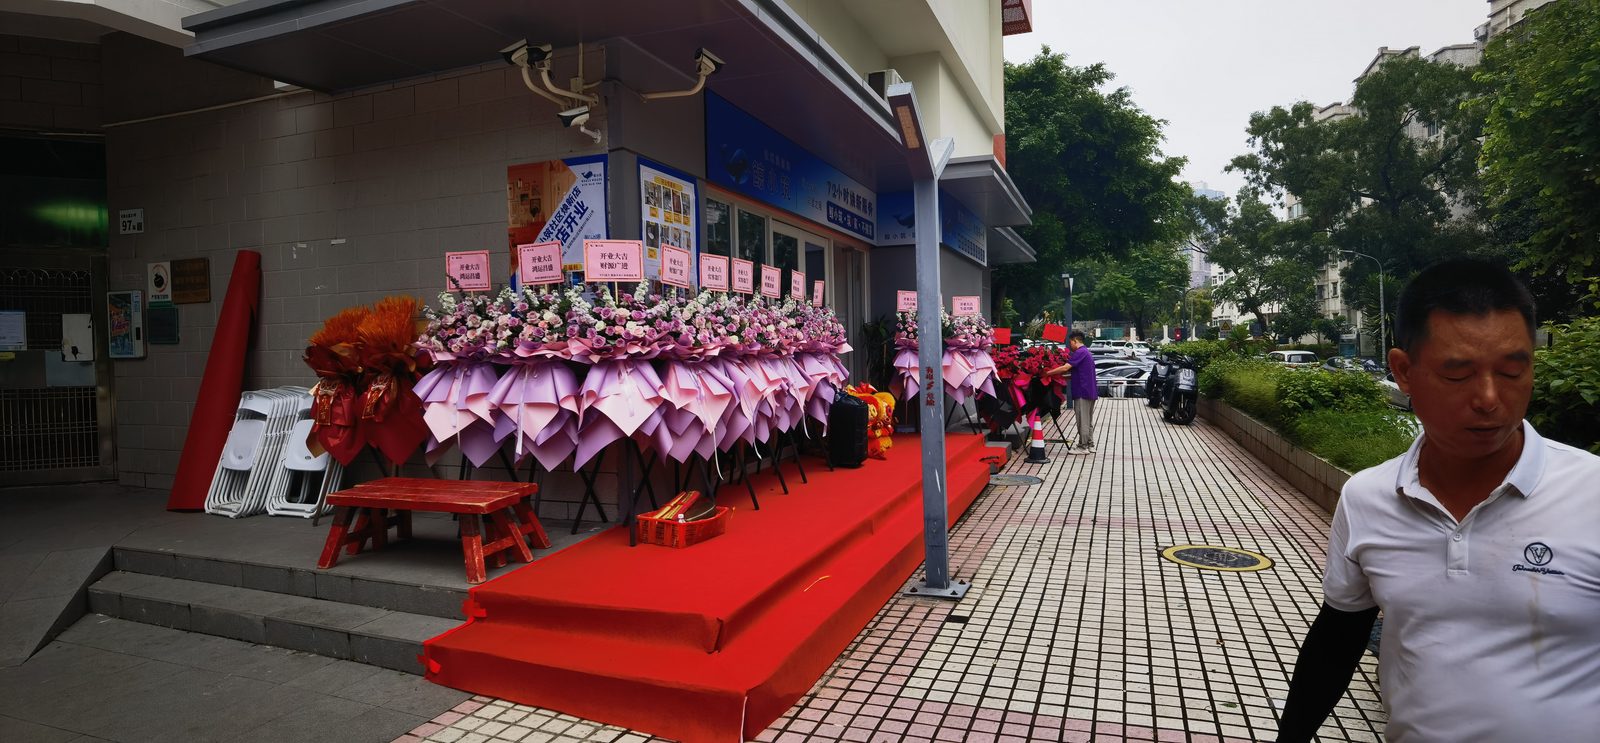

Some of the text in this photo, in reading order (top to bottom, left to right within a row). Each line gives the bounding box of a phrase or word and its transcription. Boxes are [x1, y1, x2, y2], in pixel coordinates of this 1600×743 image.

[551, 200, 589, 246] 店开业
[531, 254, 552, 263] 开业大吉
[600, 252, 629, 260] 开业大吉
[531, 264, 554, 273] 鸿运昌盛
[600, 262, 629, 270] 财源广进
